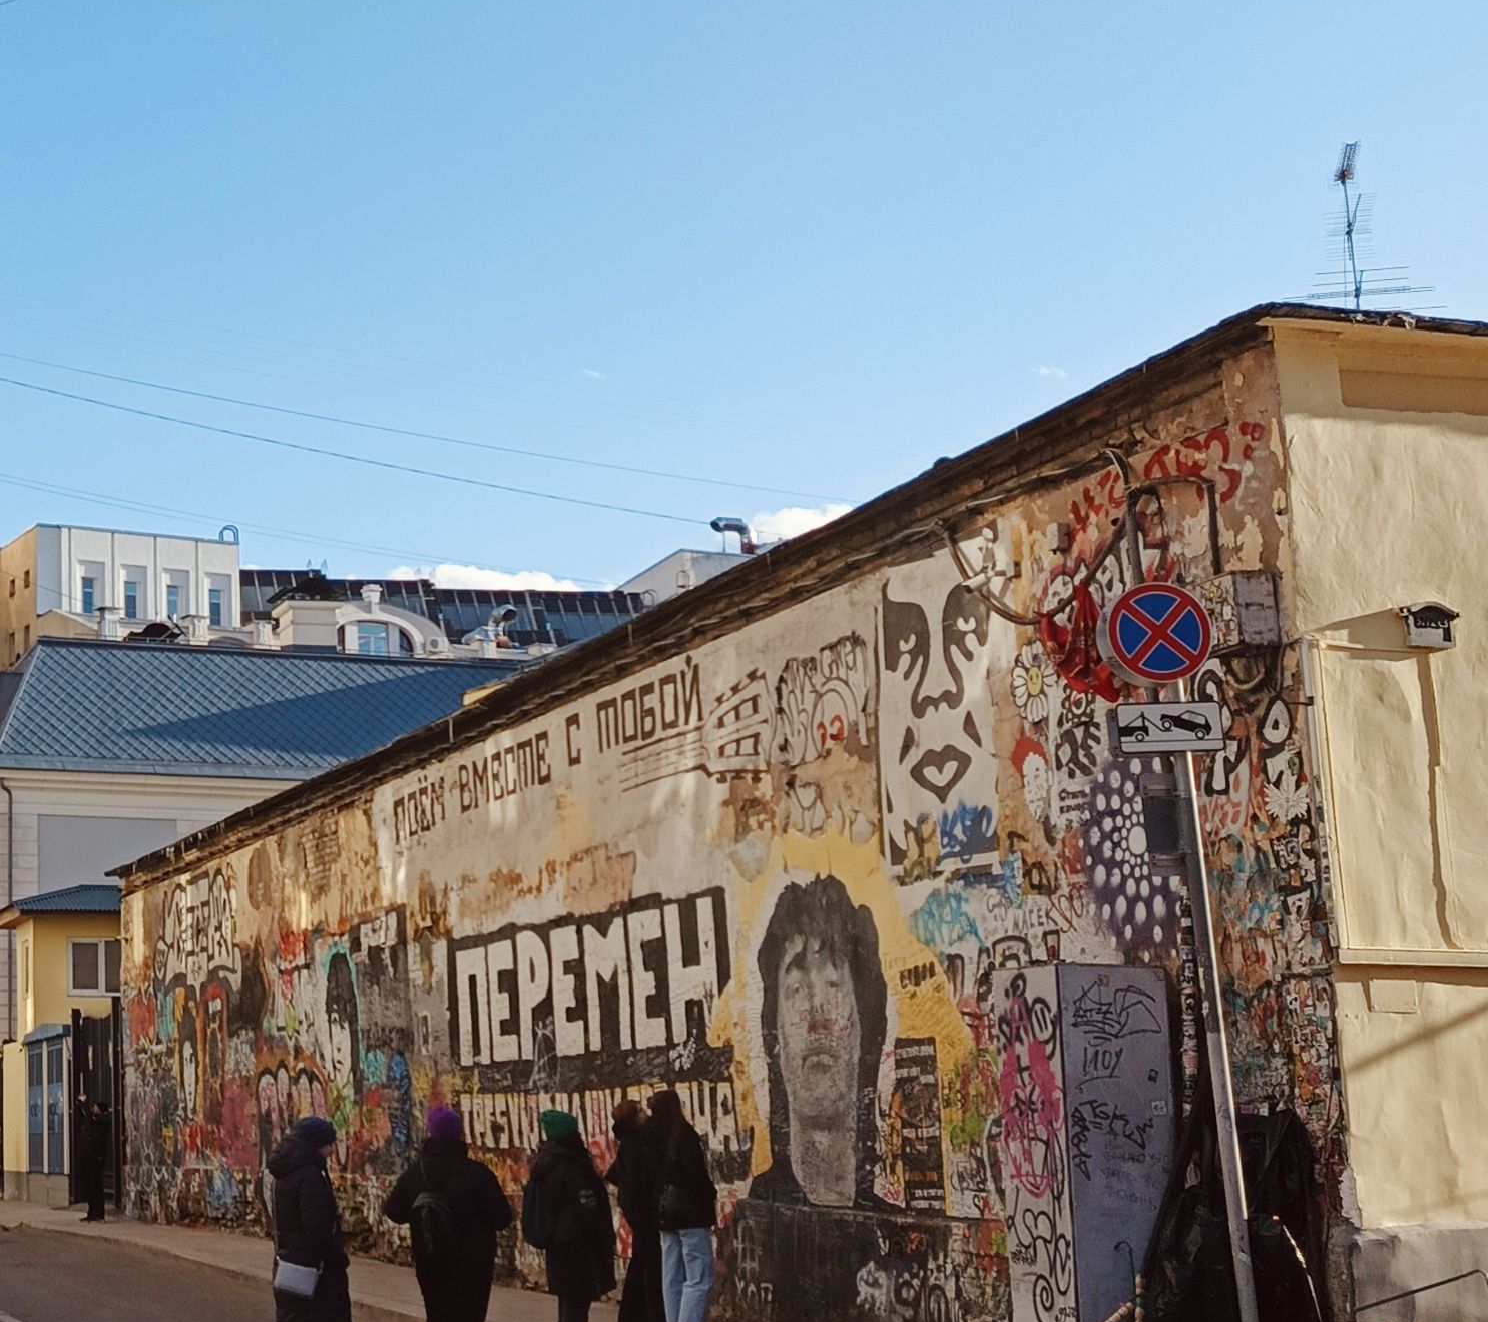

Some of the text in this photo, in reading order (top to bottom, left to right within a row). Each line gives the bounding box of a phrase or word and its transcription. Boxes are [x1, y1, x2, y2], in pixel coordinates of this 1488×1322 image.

[393, 774, 446, 845] ПОЁМ
[458, 731, 552, 814] ВМЕСТЕ
[565, 712, 582, 767] С
[596, 654, 704, 753] ТОБОЙ
[455, 896, 718, 1066] ПЕРЕМЕН
